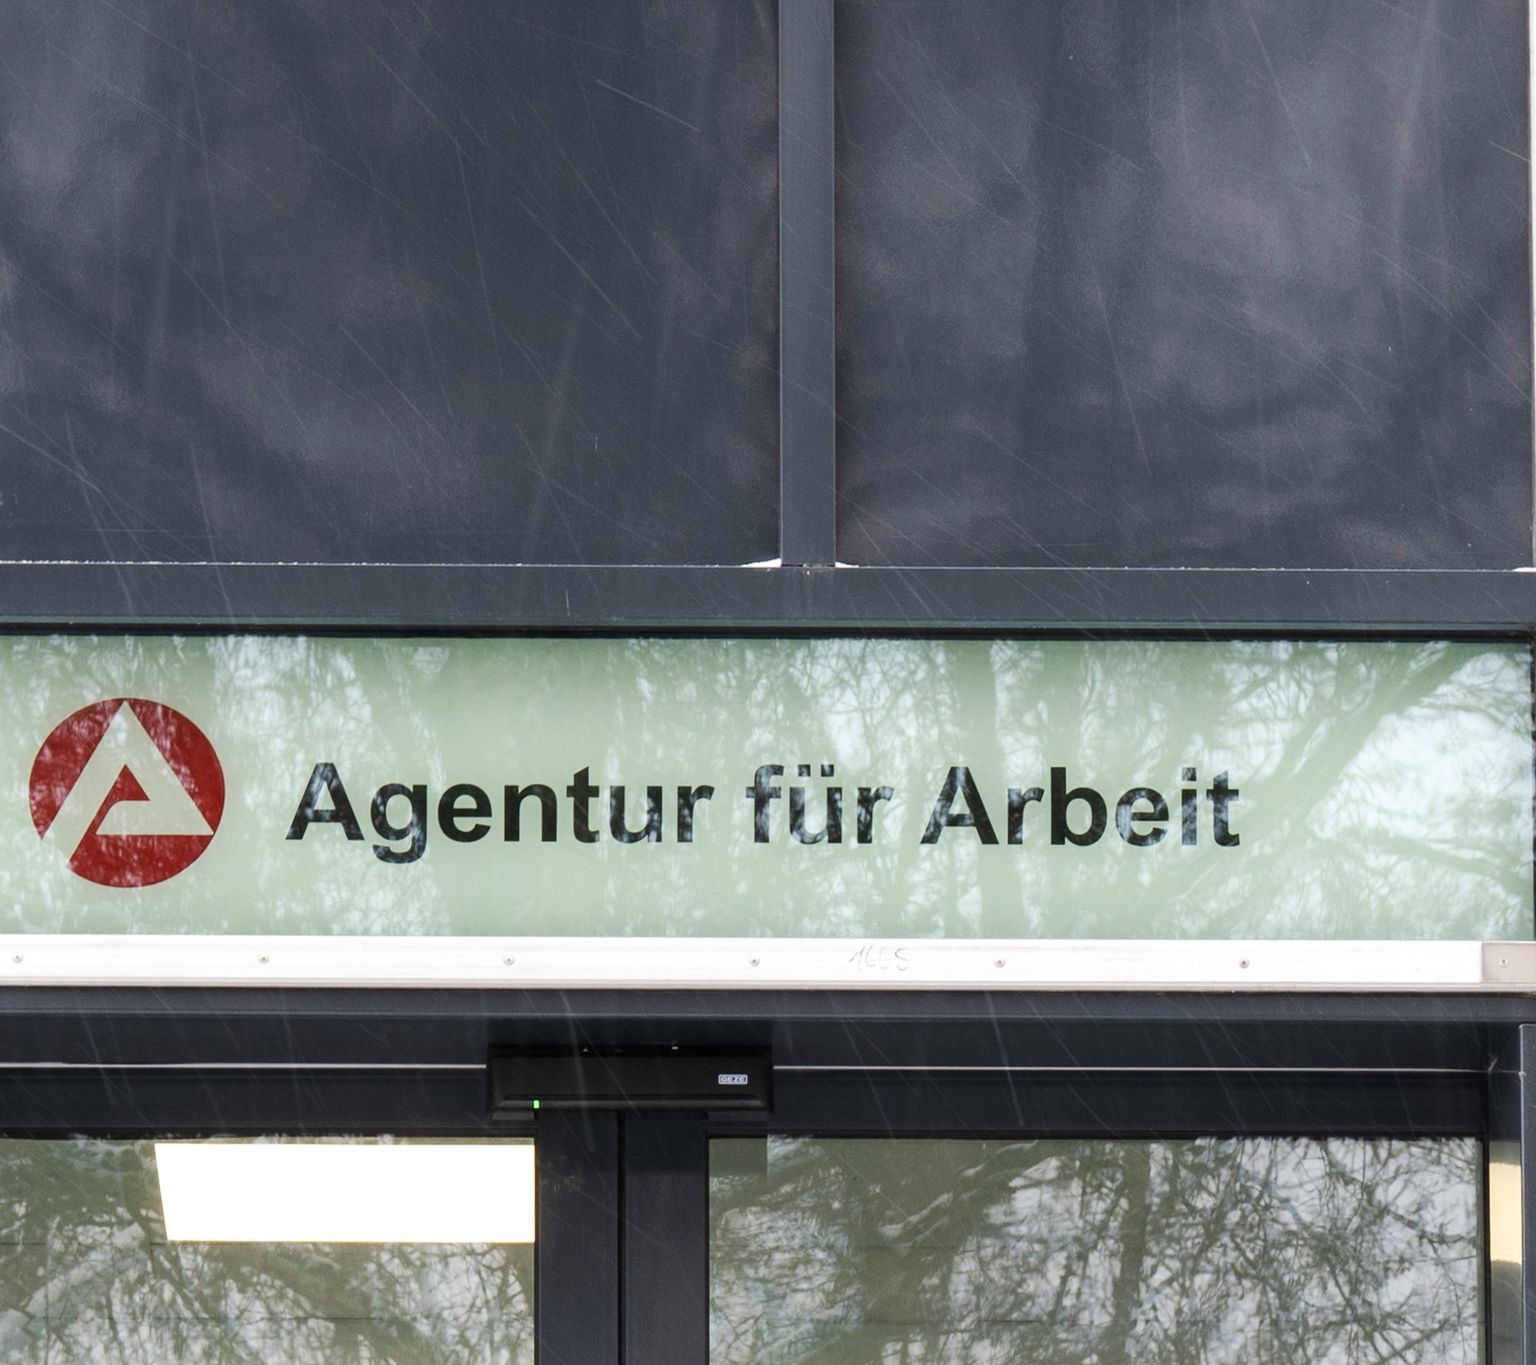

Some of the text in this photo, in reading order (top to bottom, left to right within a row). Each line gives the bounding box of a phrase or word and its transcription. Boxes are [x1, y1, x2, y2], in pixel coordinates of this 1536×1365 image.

[285, 762, 1240, 863] Agentur für Arbeit
